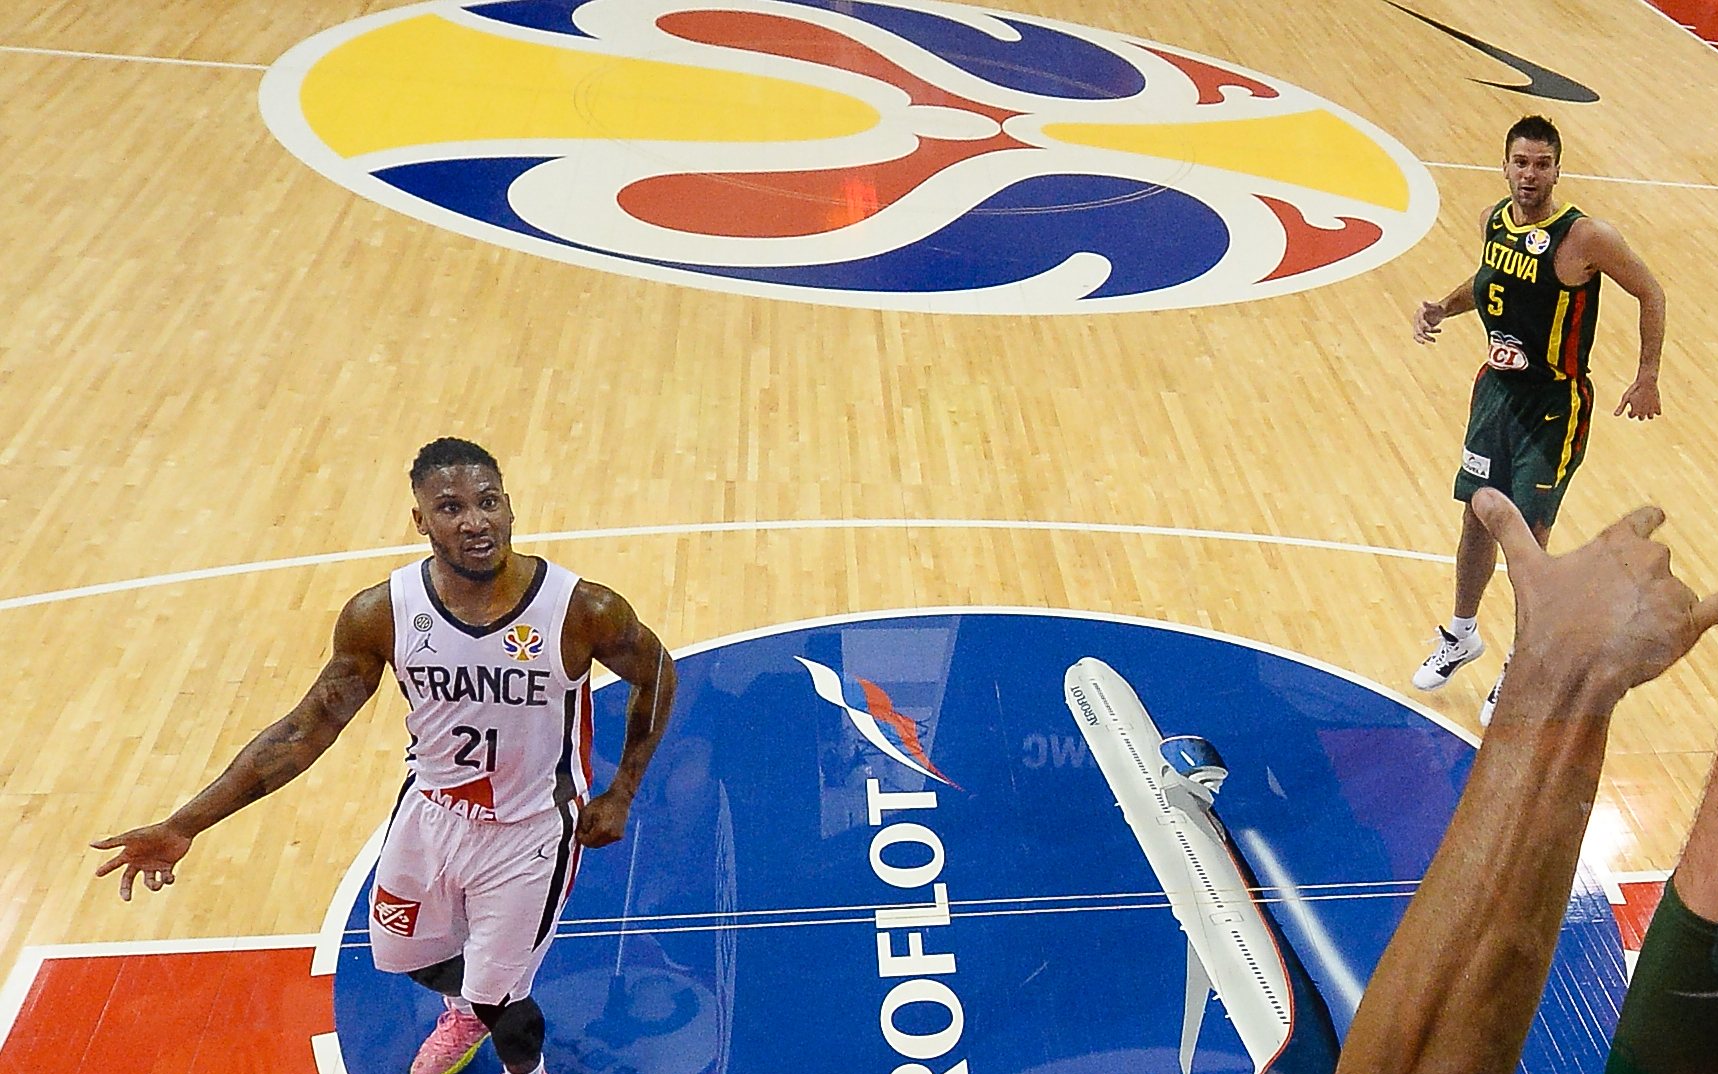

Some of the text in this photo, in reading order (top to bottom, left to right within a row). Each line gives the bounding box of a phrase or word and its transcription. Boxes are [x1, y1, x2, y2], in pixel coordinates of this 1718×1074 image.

[1487, 282, 1505, 317] 5
[406, 665, 551, 707] FRANCE
[1070, 684, 1101, 727] AEROFLOT
[451, 725, 499, 773] 21
